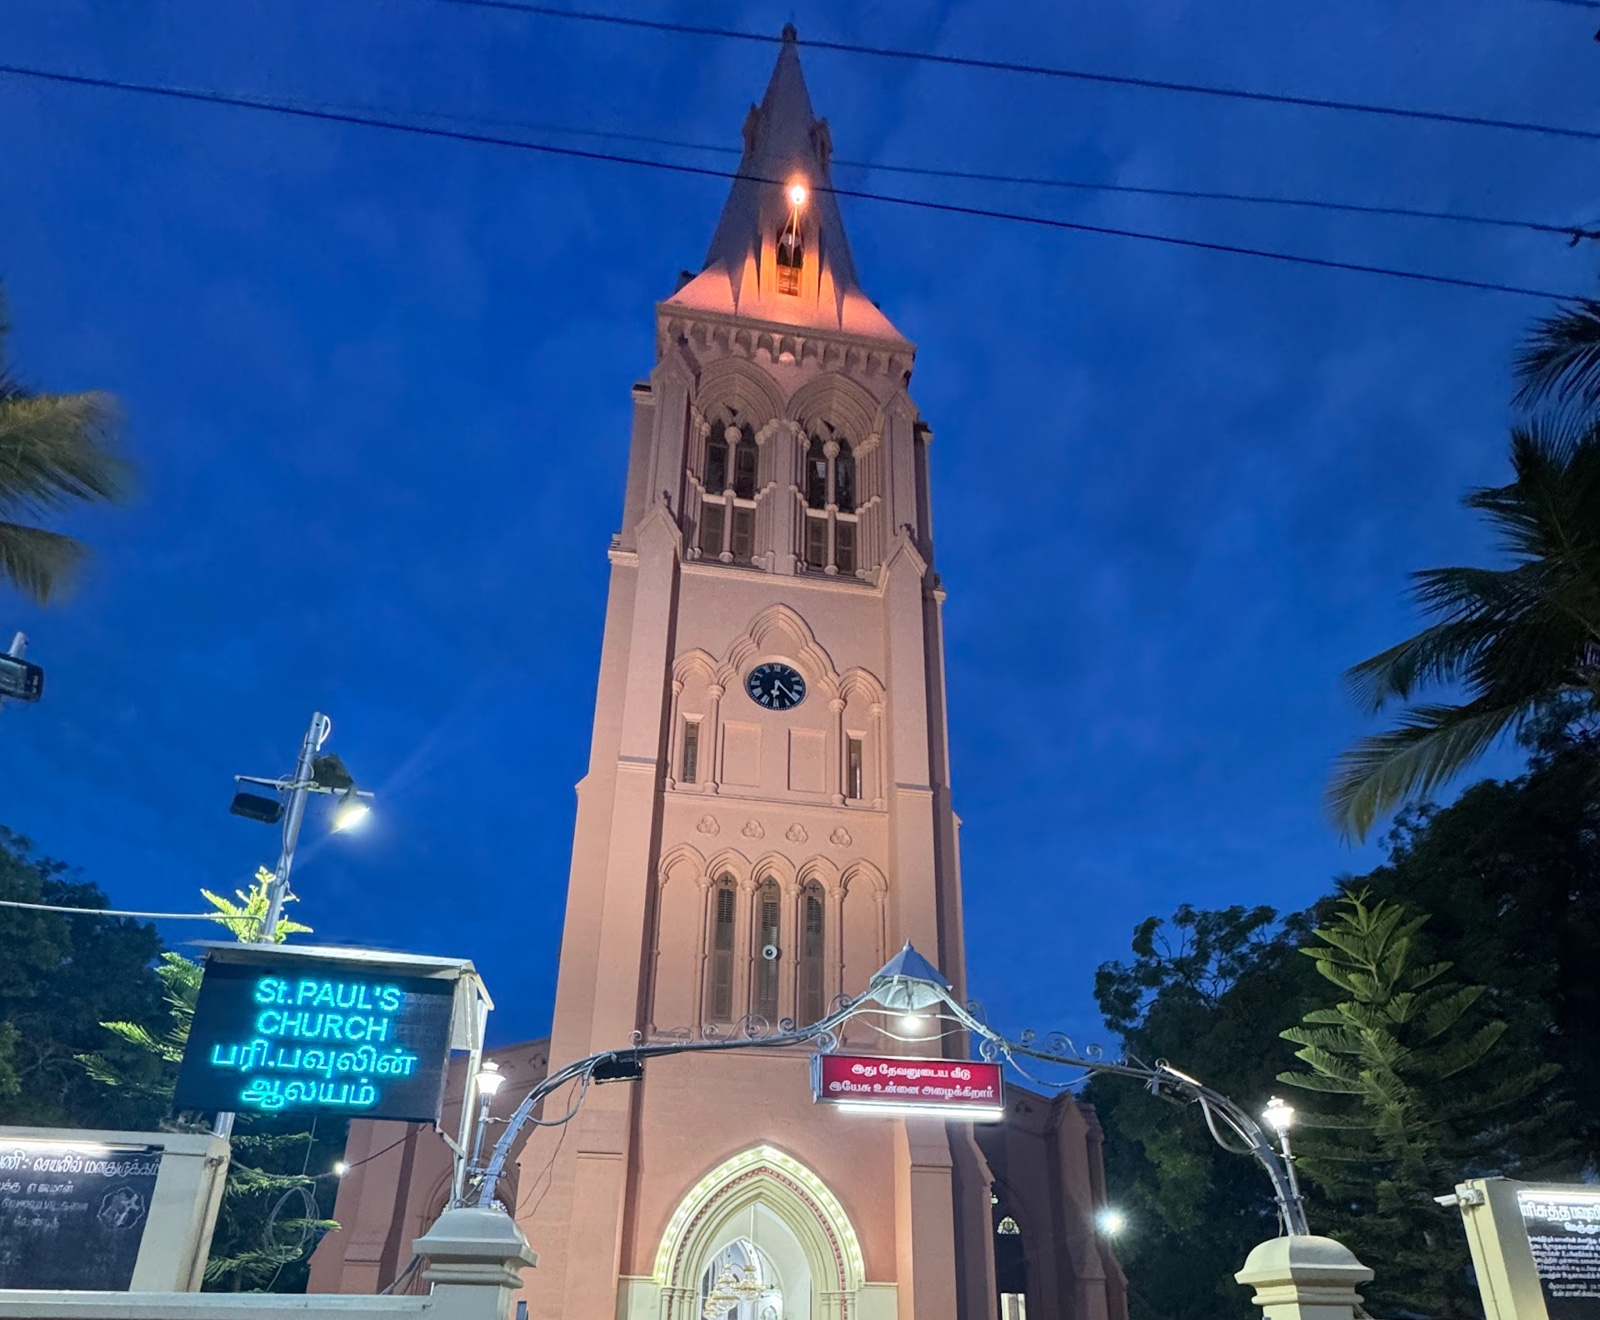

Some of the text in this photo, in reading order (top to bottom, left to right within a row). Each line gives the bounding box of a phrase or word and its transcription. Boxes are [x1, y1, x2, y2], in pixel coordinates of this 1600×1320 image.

[257, 1010, 389, 1042] CHURCH
[851, 1063, 972, 1081] இது தேவனுடைய வீடு
[241, 1078, 377, 1110] ஆலயம்
[828, 1080, 994, 1100] இயேசு உன்னை அழைக்கிறார்
